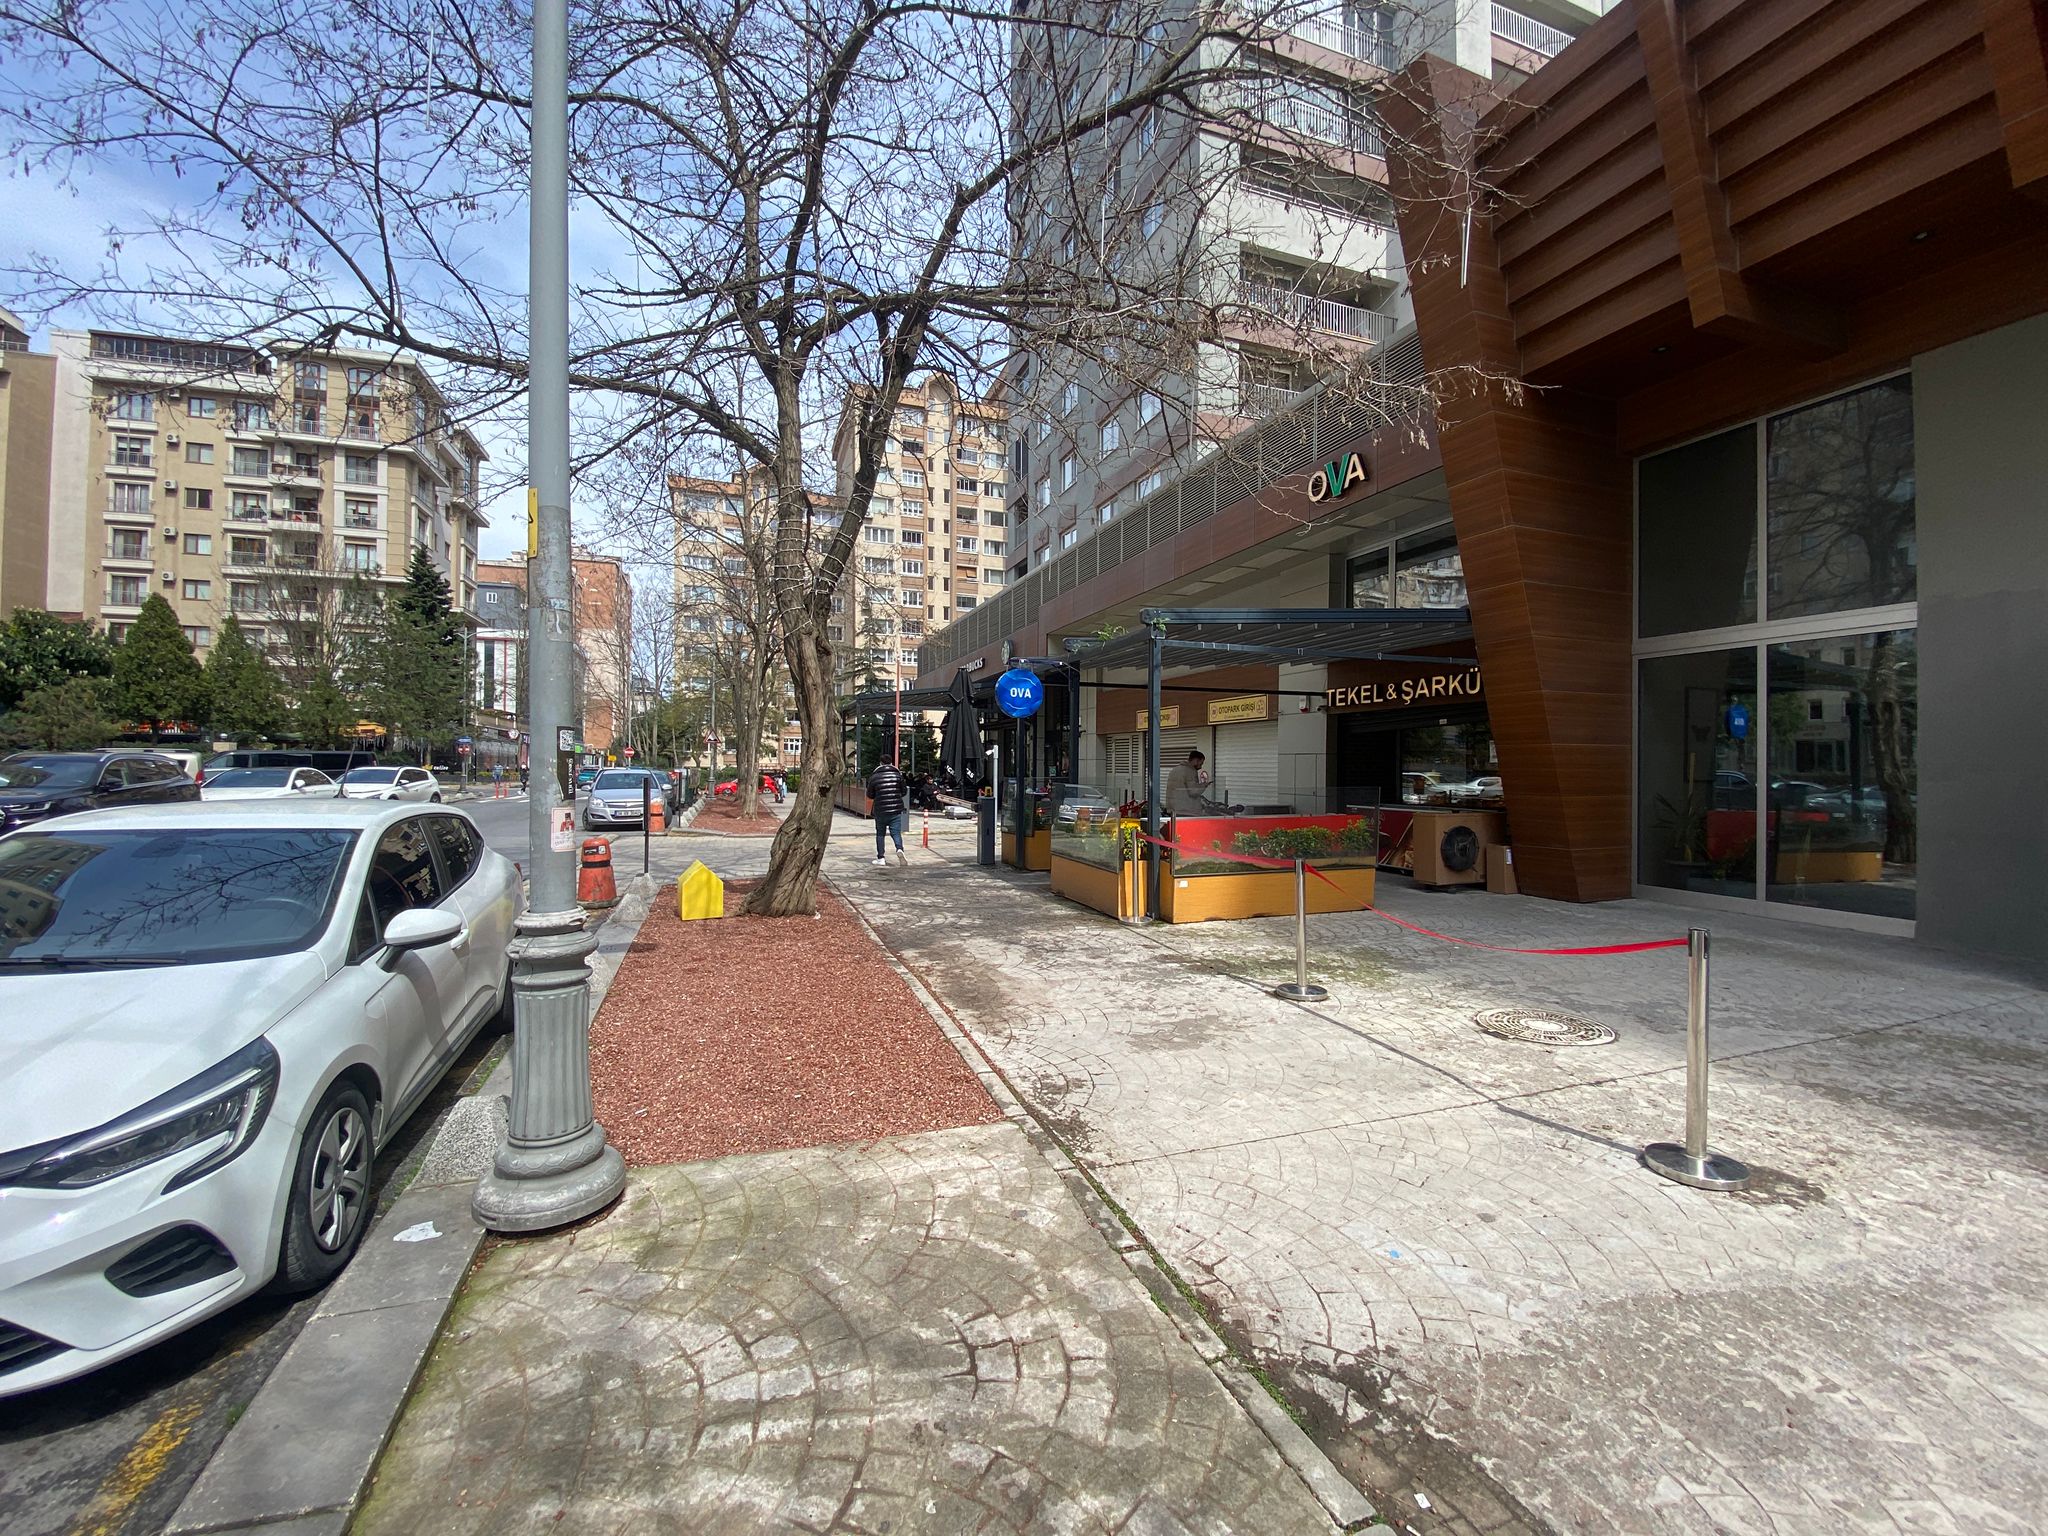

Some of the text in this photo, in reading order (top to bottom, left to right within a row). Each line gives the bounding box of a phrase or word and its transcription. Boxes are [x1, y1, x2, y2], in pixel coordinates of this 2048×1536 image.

[1307, 452, 1367, 503] OVA
[1010, 687, 1032, 698] OVA
[1325, 667, 1481, 707] TEKEL & ŞARKÜ
[1218, 704, 1240, 714] OTOPARK
